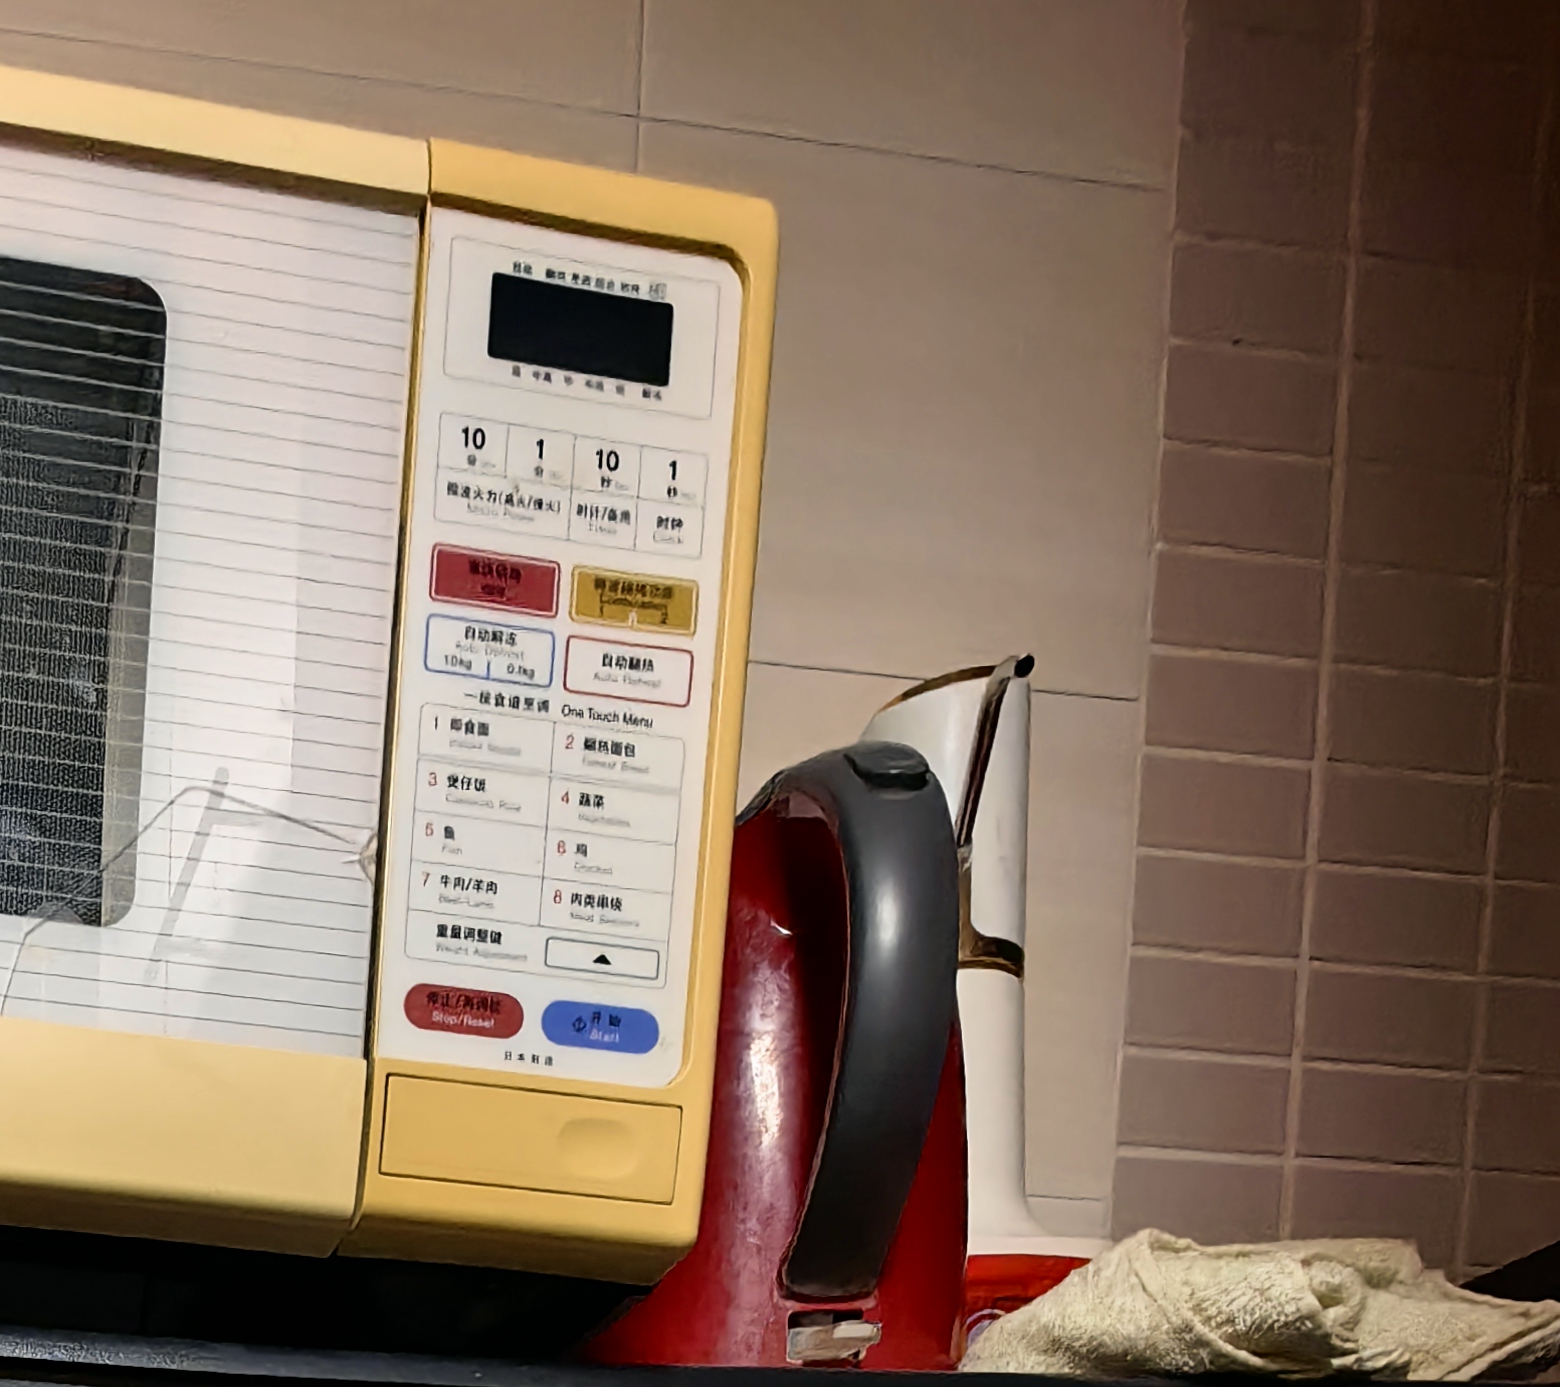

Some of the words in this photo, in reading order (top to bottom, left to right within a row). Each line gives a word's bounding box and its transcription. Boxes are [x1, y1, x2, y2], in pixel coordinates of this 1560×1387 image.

[461, 426, 487, 450] 10
[536, 438, 545, 460] 1
[596, 448, 620, 472] 10
[668, 460, 678, 481] 1
[561, 704, 585, 720] One
[588, 707, 620, 724] Touch
[622, 711, 654, 729] Menu
[564, 734, 575, 750] 2
[428, 772, 438, 787] 3
[561, 790, 570, 805] 4
[424, 822, 434, 837] 5
[556, 840, 567, 856] 6
[421, 871, 430, 887] 7
[552, 889, 563, 905] 8
[430, 1010, 496, 1029] Stop/Reset
[589, 1028, 620, 1044] Start
